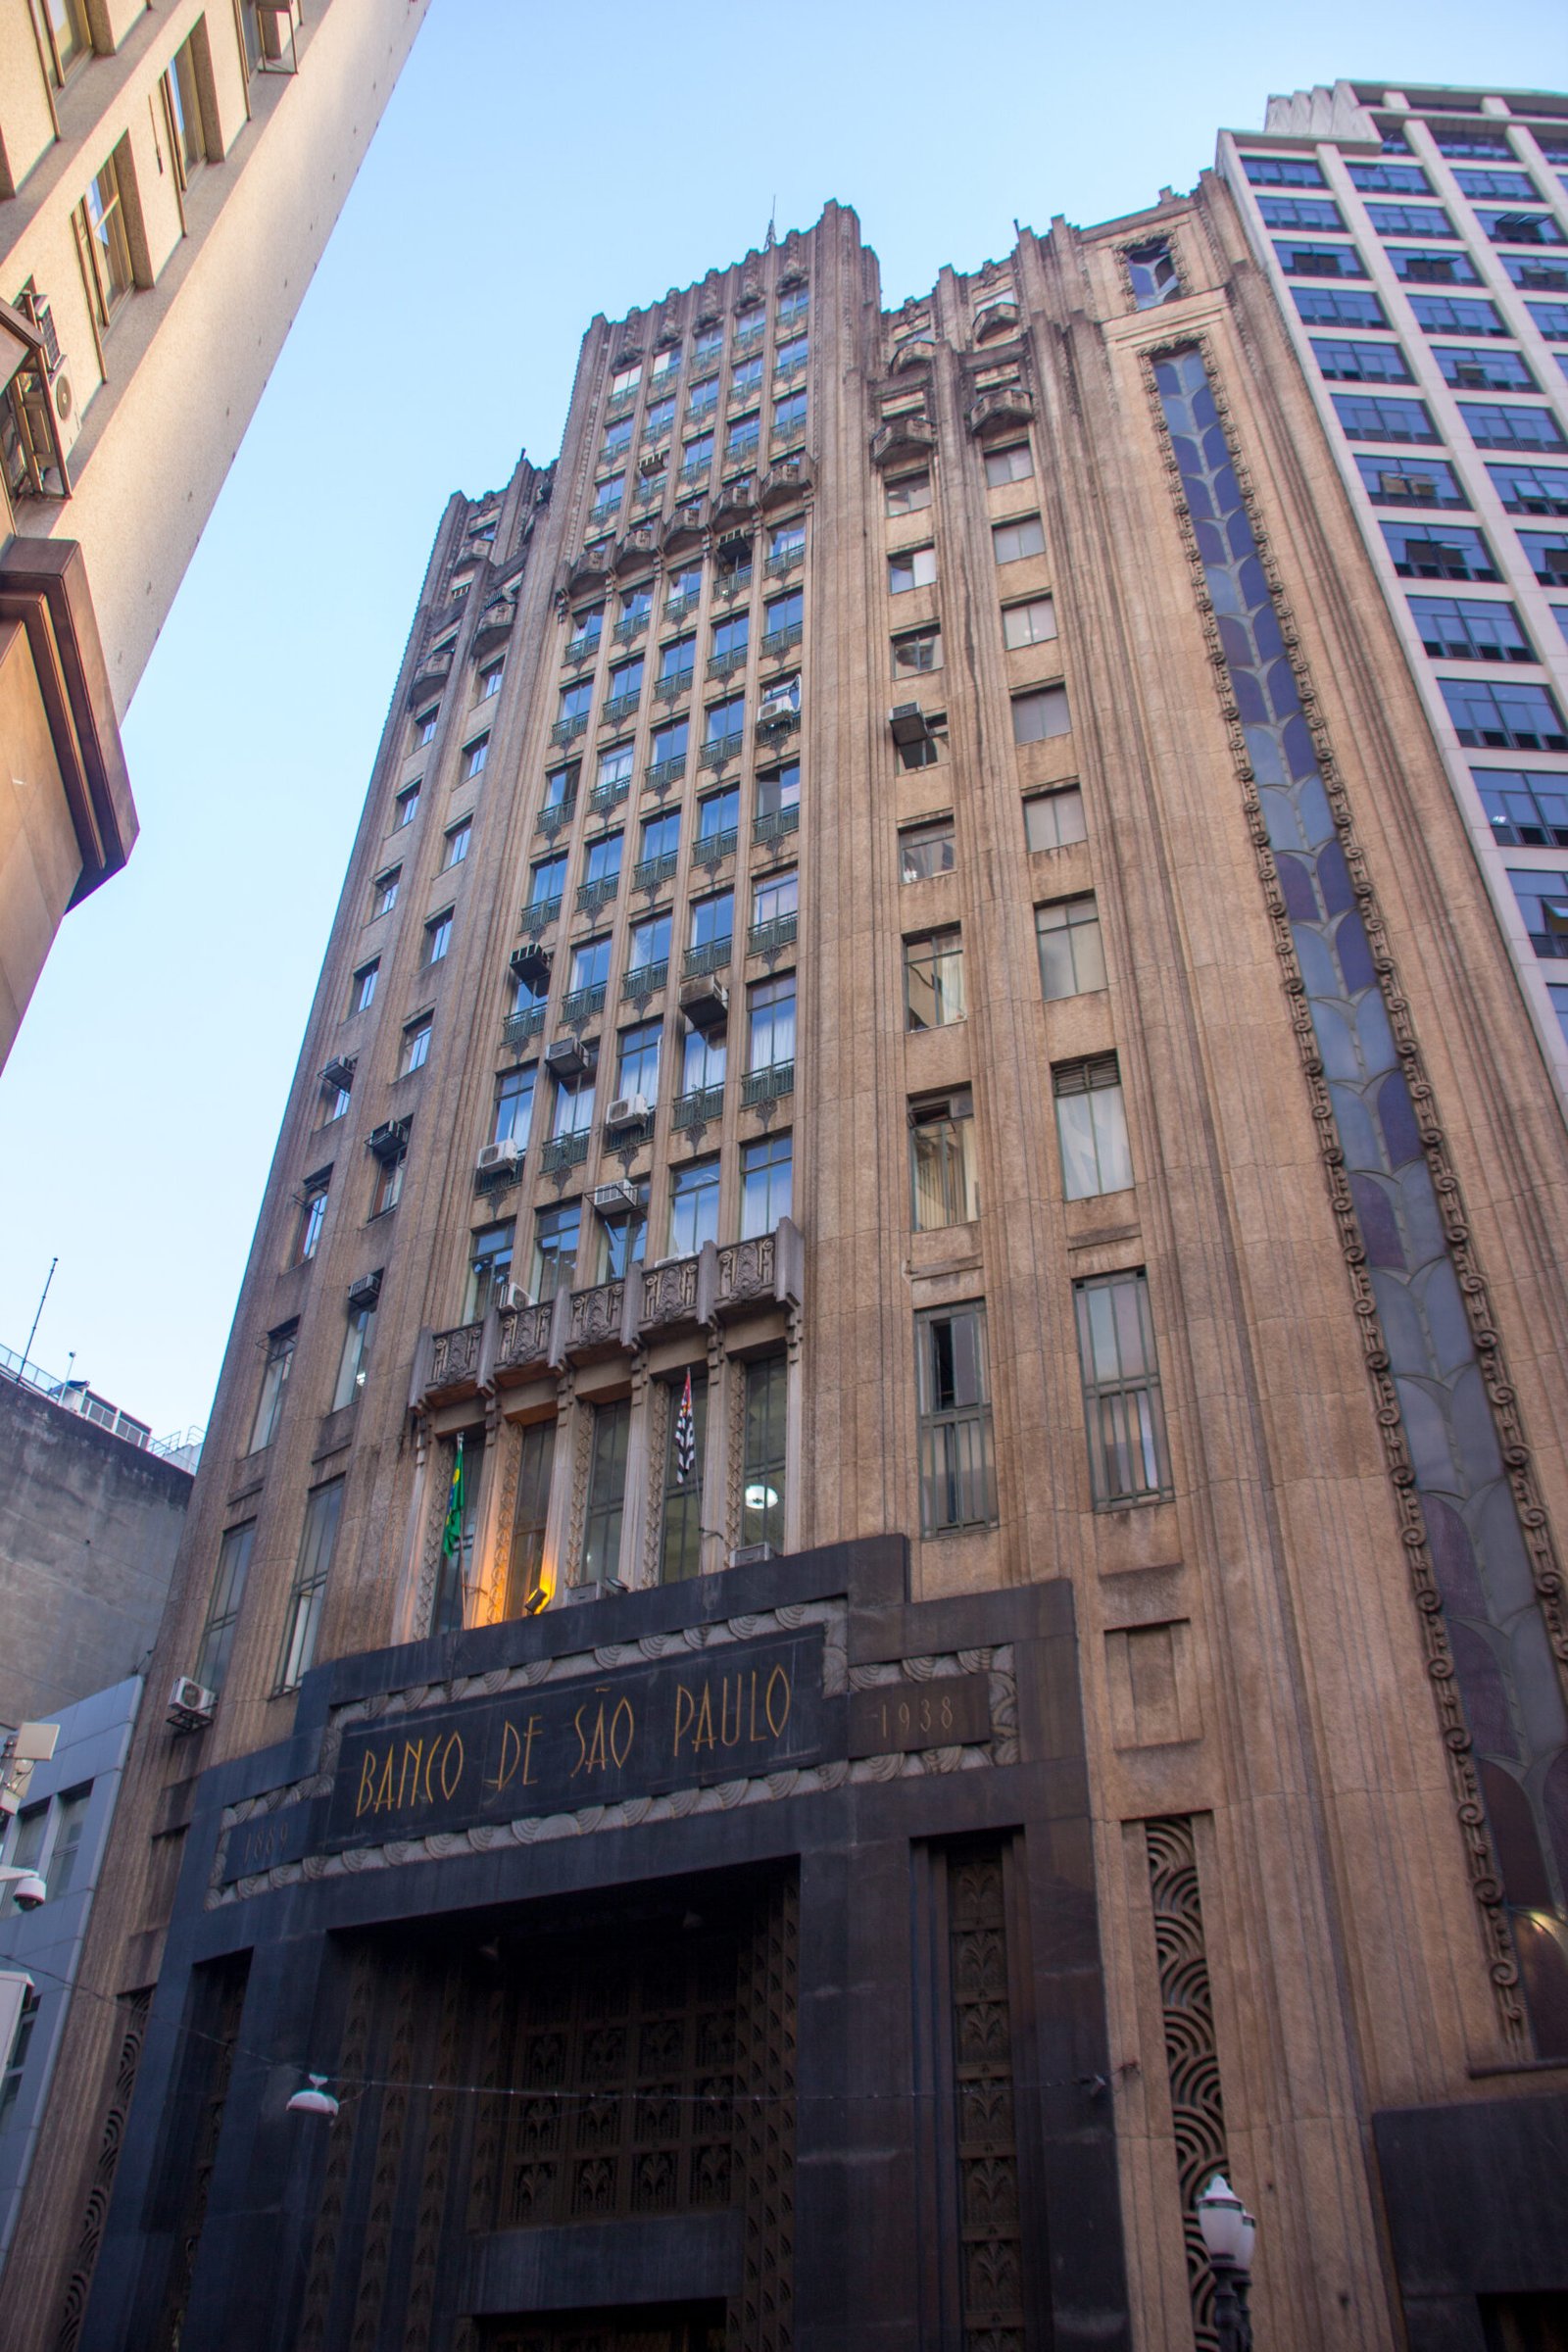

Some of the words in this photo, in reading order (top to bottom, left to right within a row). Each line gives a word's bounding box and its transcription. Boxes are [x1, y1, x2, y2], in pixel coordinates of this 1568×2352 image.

[880, 1696, 955, 1739] 1938
[356, 1731, 465, 1818] BANCO
[497, 1716, 544, 1791] DE
[571, 1687, 635, 1779] SÃO
[674, 1664, 791, 1757] PAULO
[243, 1821, 289, 1866] 1889
